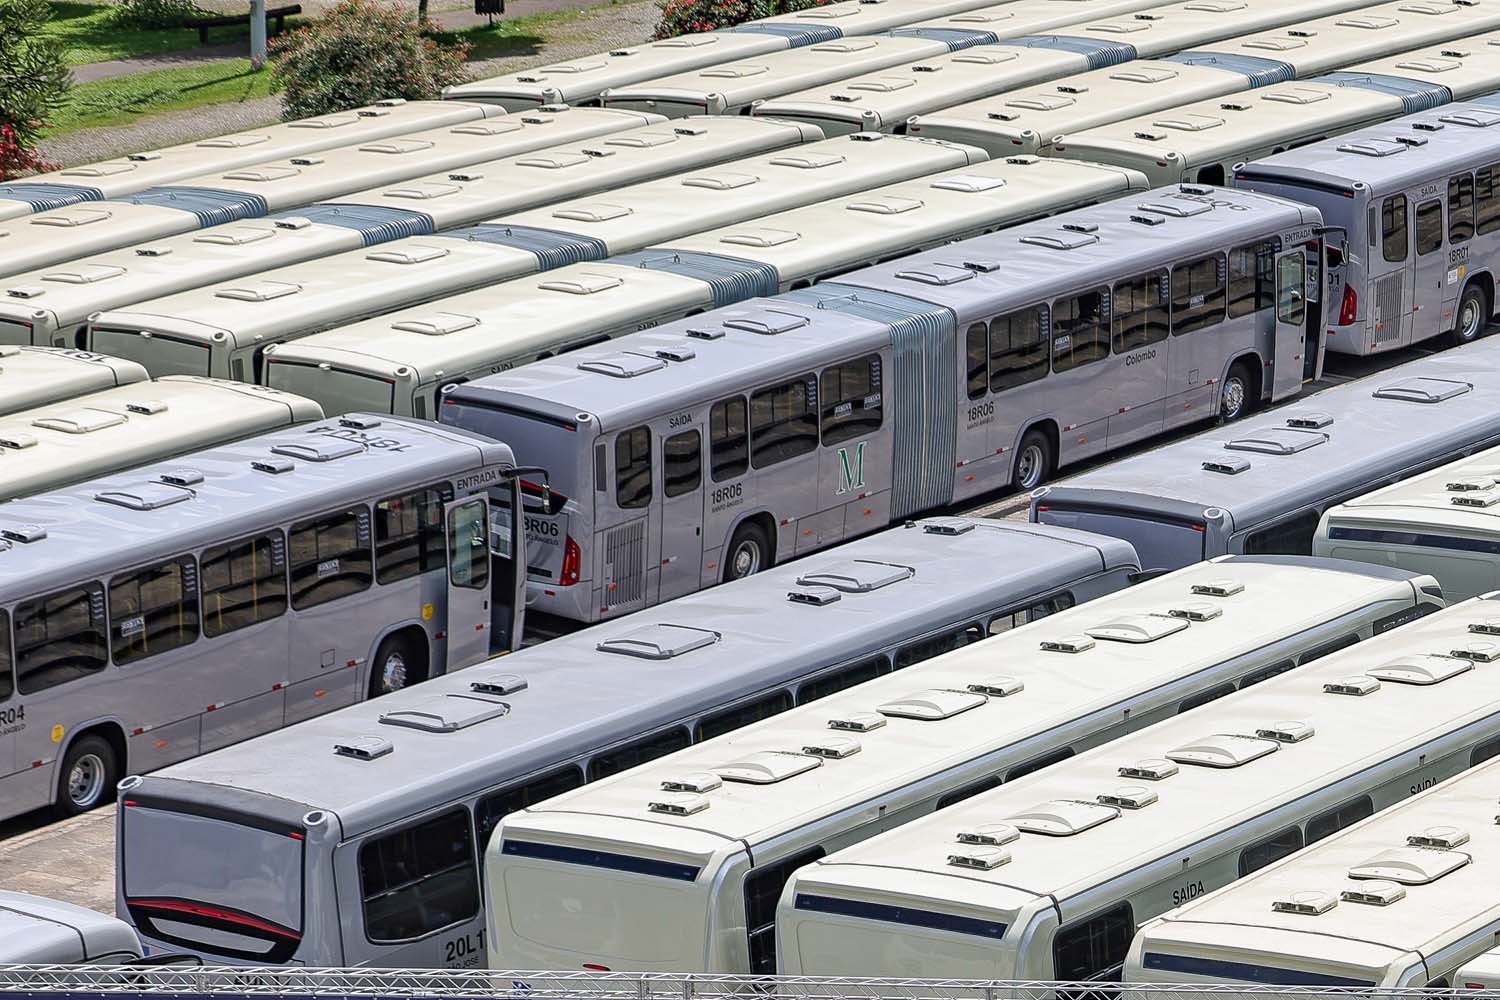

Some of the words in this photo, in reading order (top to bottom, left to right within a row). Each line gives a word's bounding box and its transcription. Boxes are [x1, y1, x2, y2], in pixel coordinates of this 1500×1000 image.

[1421, 184, 1439, 197] SAÍDA
[1448, 247, 1469, 263] 18R01
[1125, 350, 1157, 366] Colombo
[670, 411, 693, 428] SAÍDA
[968, 401, 995, 421] 18R06
[837, 441, 868, 495] M
[457, 470, 497, 491] ENTRADA
[711, 482, 743, 504] 18R06
[1410, 777, 1438, 796] SAÍDA
[1172, 880, 1204, 905] SAÍDA
